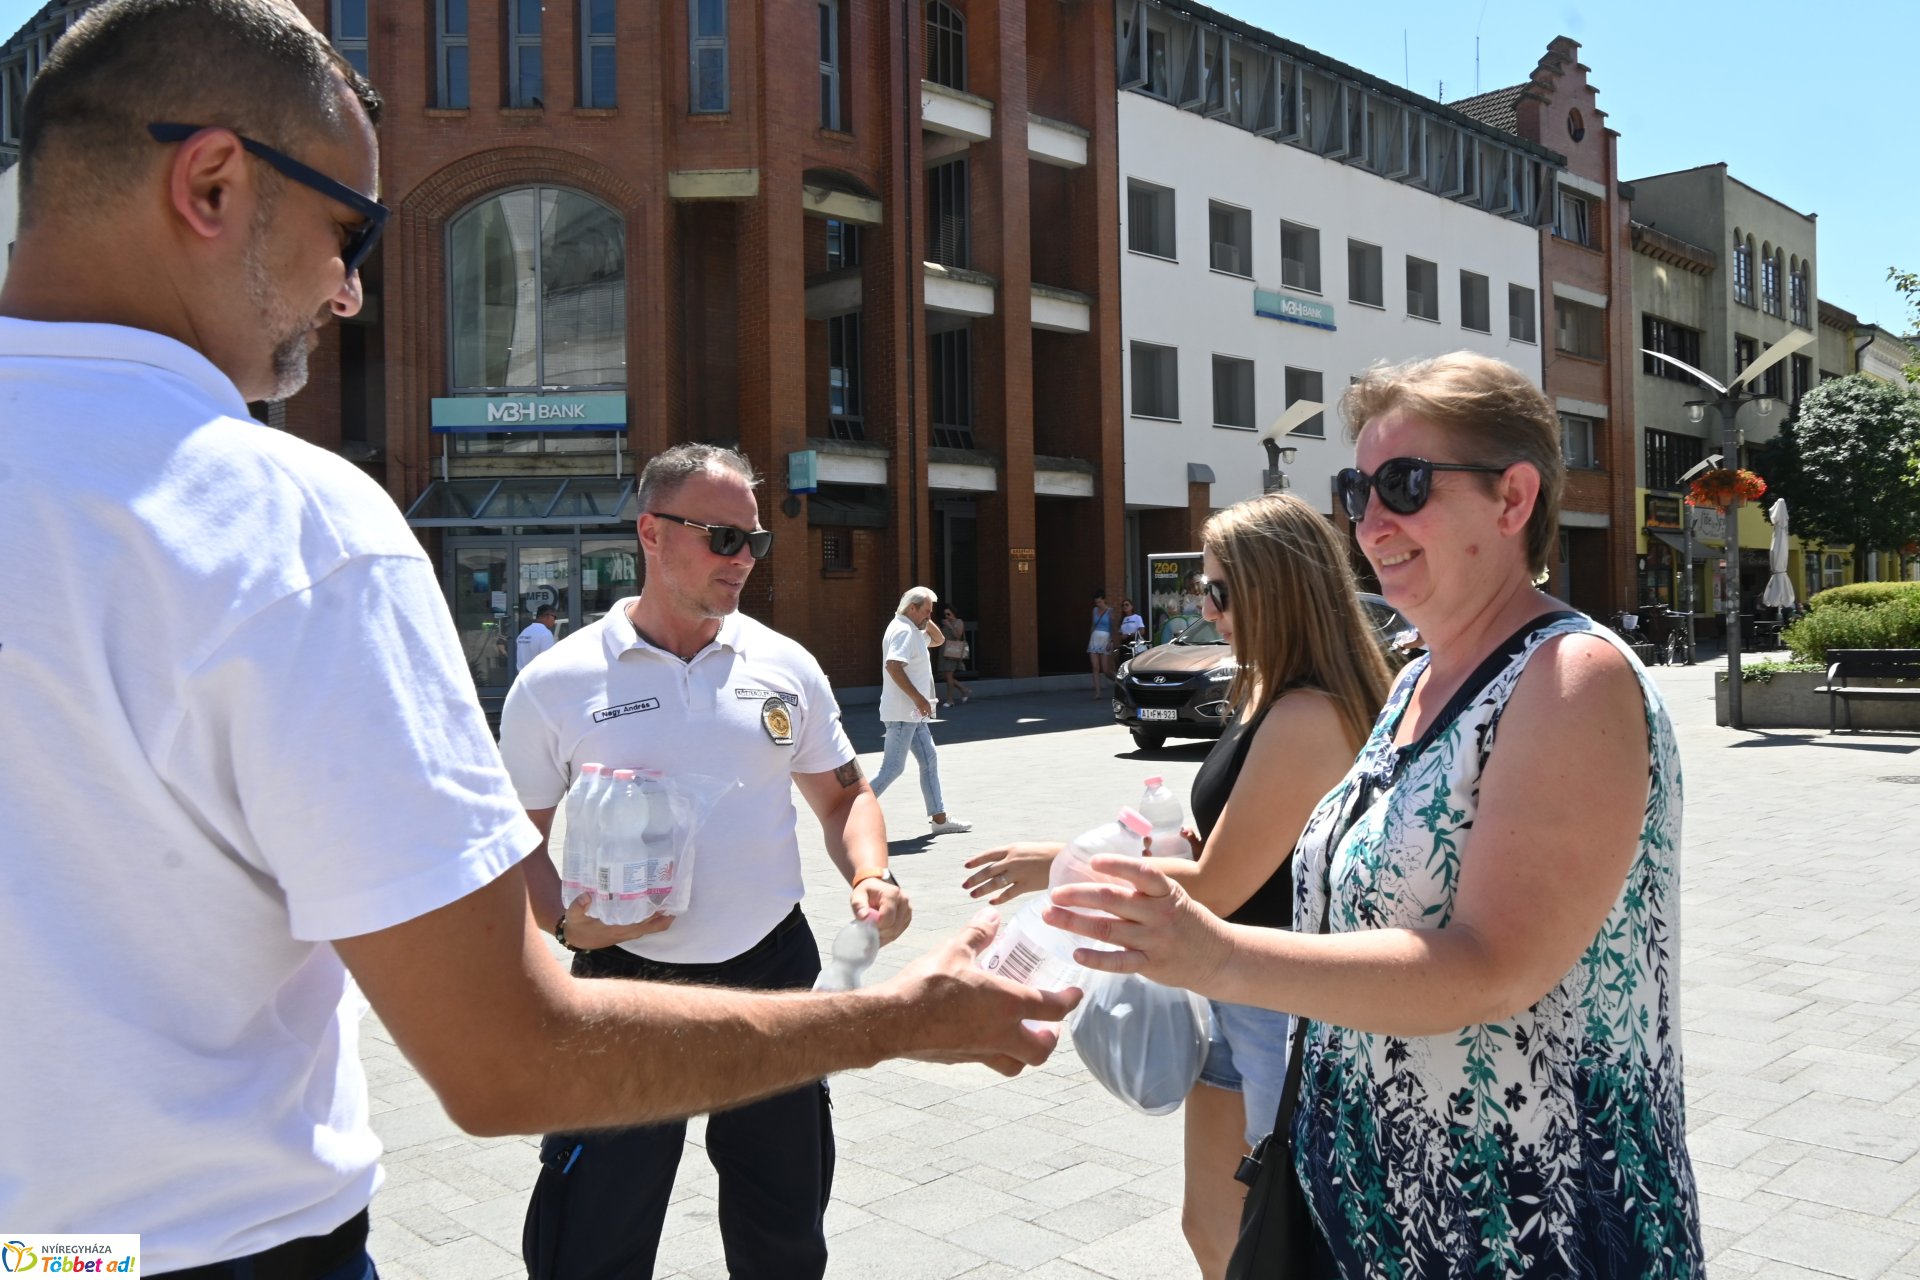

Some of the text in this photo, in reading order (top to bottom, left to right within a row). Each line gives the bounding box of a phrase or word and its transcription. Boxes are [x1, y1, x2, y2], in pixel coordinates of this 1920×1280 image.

[1302, 305, 1322, 318] BANK
[487, 402, 585, 422] MBH BANK
[1154, 562, 1178, 574] ZOO
[526, 591, 549, 601] MFB
[601, 708, 621, 718] Nagy
